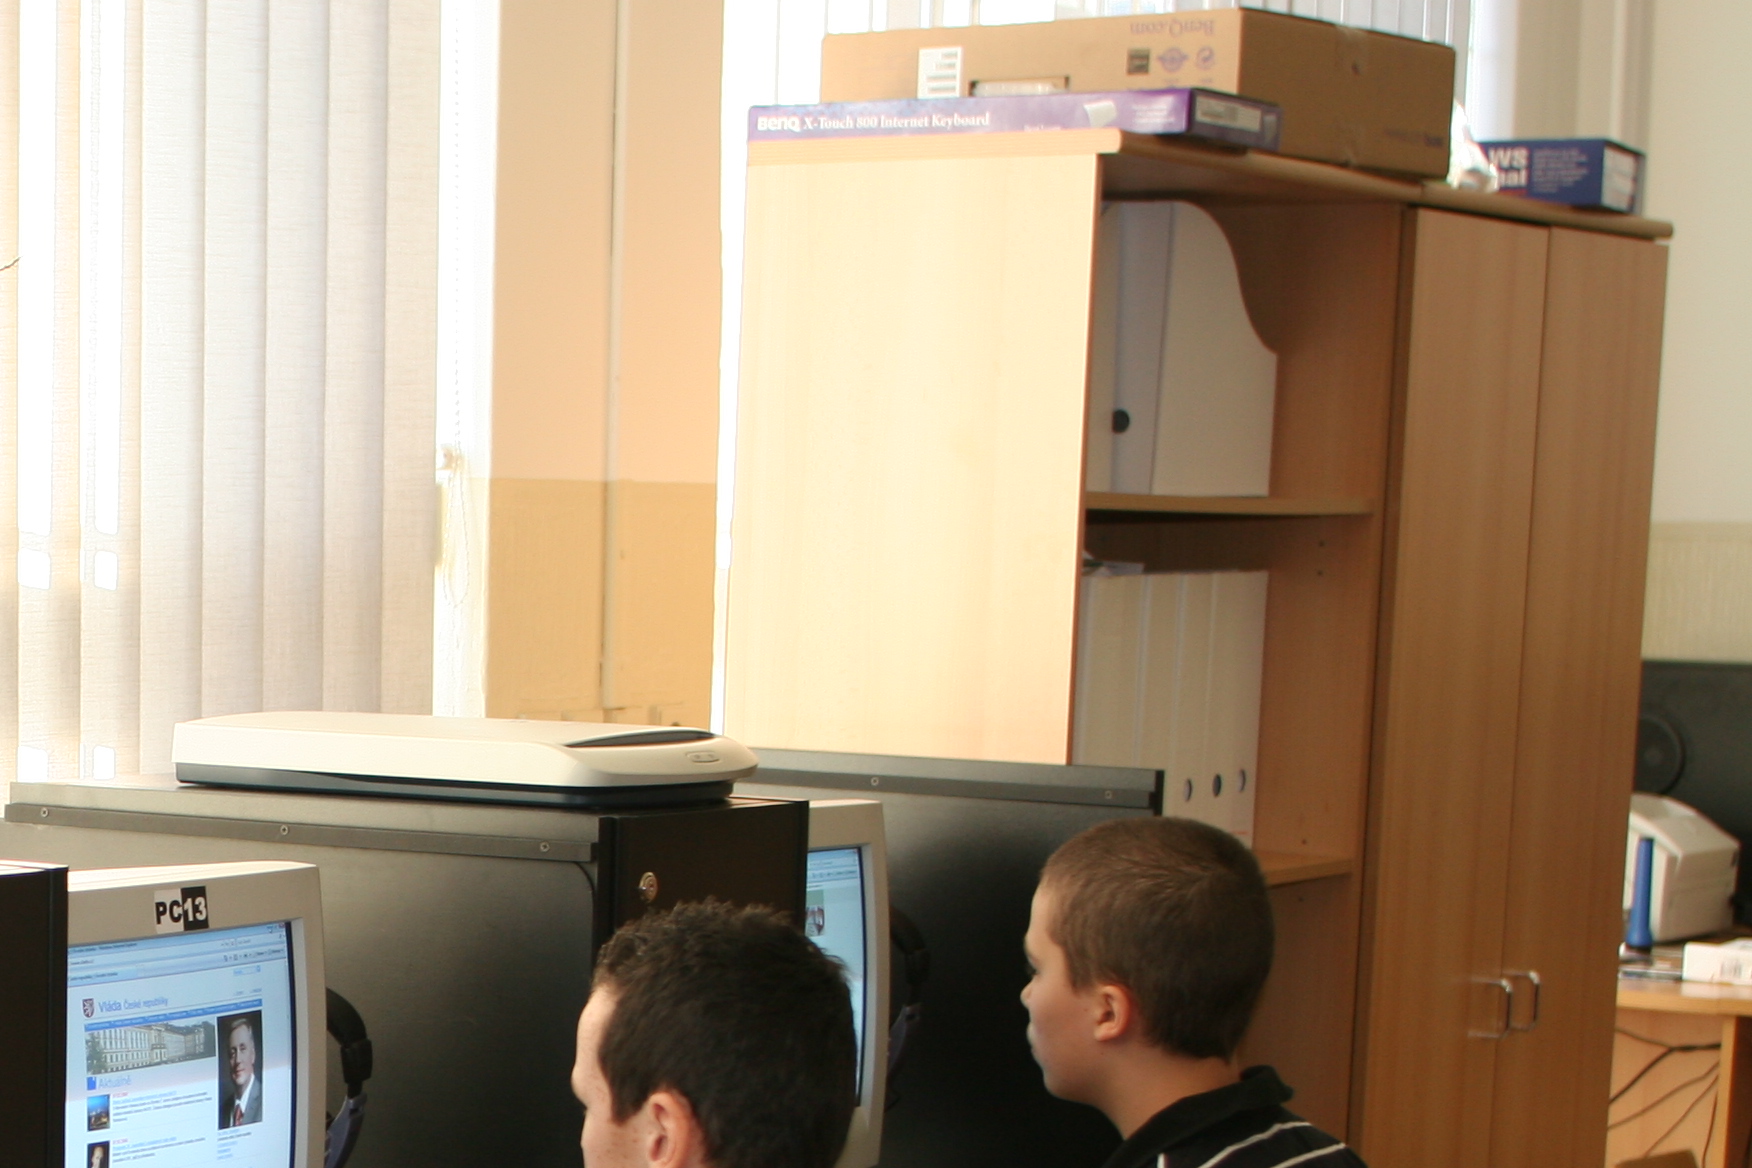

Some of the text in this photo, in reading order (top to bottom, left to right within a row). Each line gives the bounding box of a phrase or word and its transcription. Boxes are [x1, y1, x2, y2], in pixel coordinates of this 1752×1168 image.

[757, 112, 990, 133] BenQ X-Touch 800 Internet Keyboard
[155, 896, 207, 925] PC13
